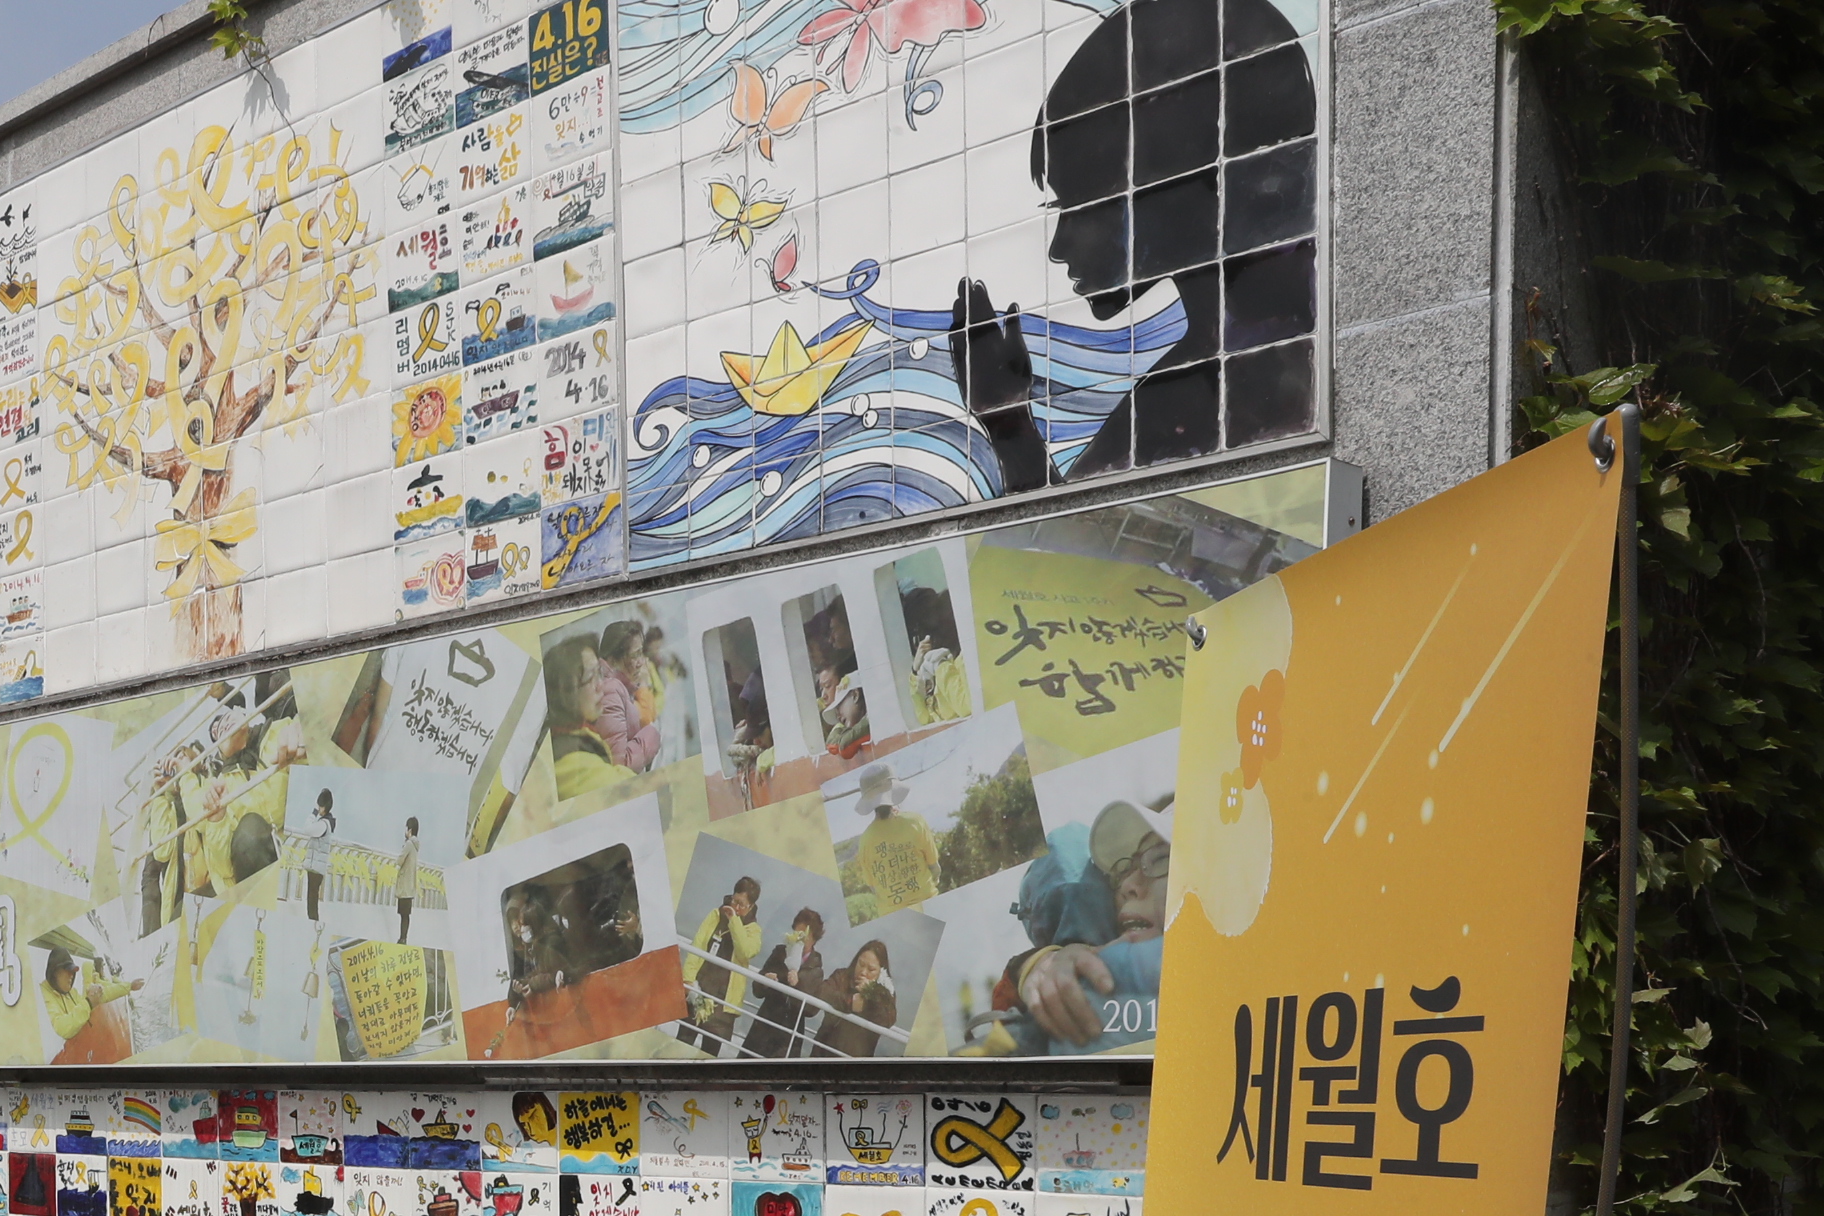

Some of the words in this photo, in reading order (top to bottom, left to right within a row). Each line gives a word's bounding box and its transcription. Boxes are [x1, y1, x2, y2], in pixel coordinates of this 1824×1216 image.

[532, 0, 602, 53] 4.16
[531, 36, 598, 90] 진실은?
[543, 340, 586, 379] 2014
[1216, 976, 1485, 1191] 세월호
[563, 1094, 628, 1120] 하늘에서는
[857, 1151, 883, 1162] 세월호
[353, 1172, 371, 1186] 잊지
[838, 1170, 899, 1185] REMEMBER
[590, 1182, 613, 1208] 잊지
